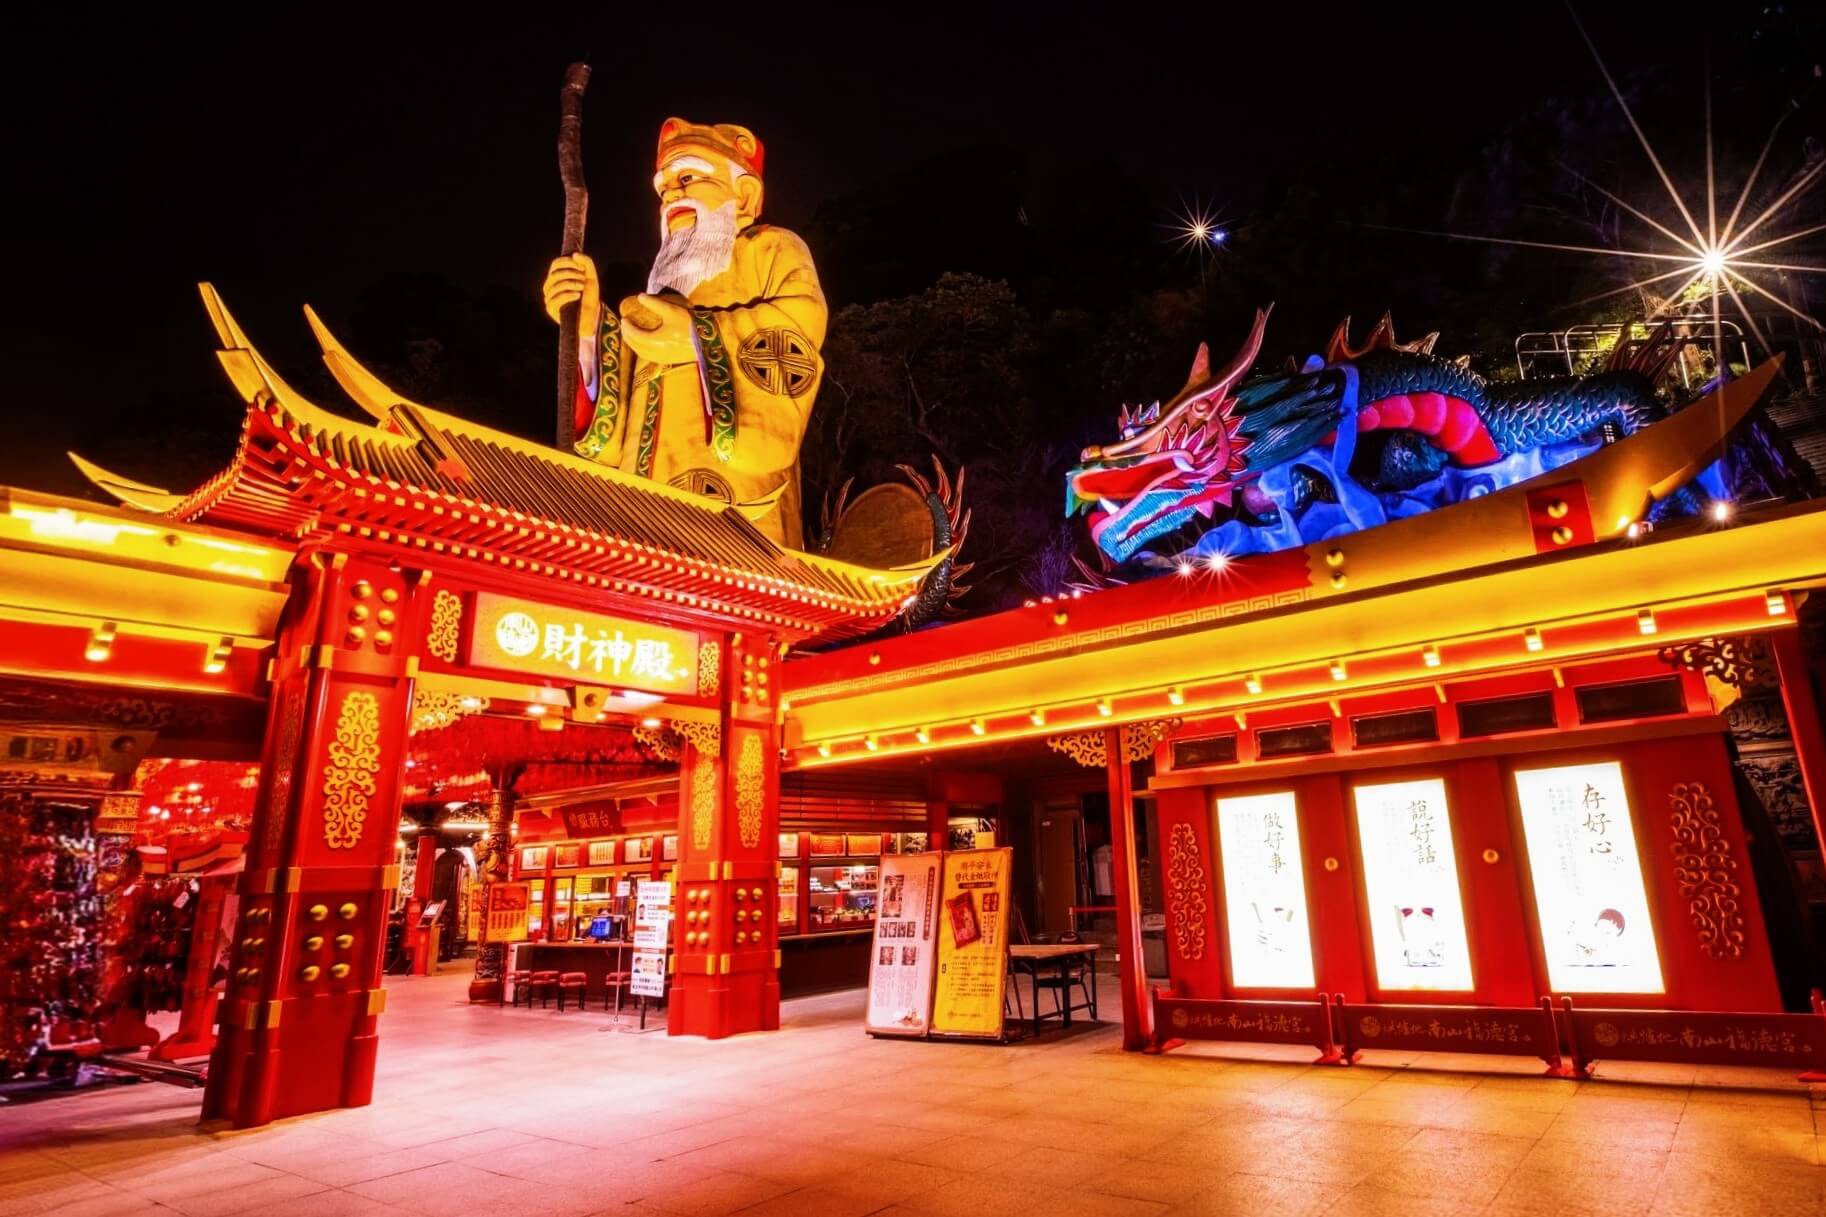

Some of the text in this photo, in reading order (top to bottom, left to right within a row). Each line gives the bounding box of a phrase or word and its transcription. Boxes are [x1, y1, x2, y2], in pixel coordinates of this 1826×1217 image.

[541, 624, 674, 680] 財神殿
[1264, 812, 1286, 874] 做好事
[1407, 800, 1437, 864] 說好話
[1582, 783, 1613, 854] 存好心
